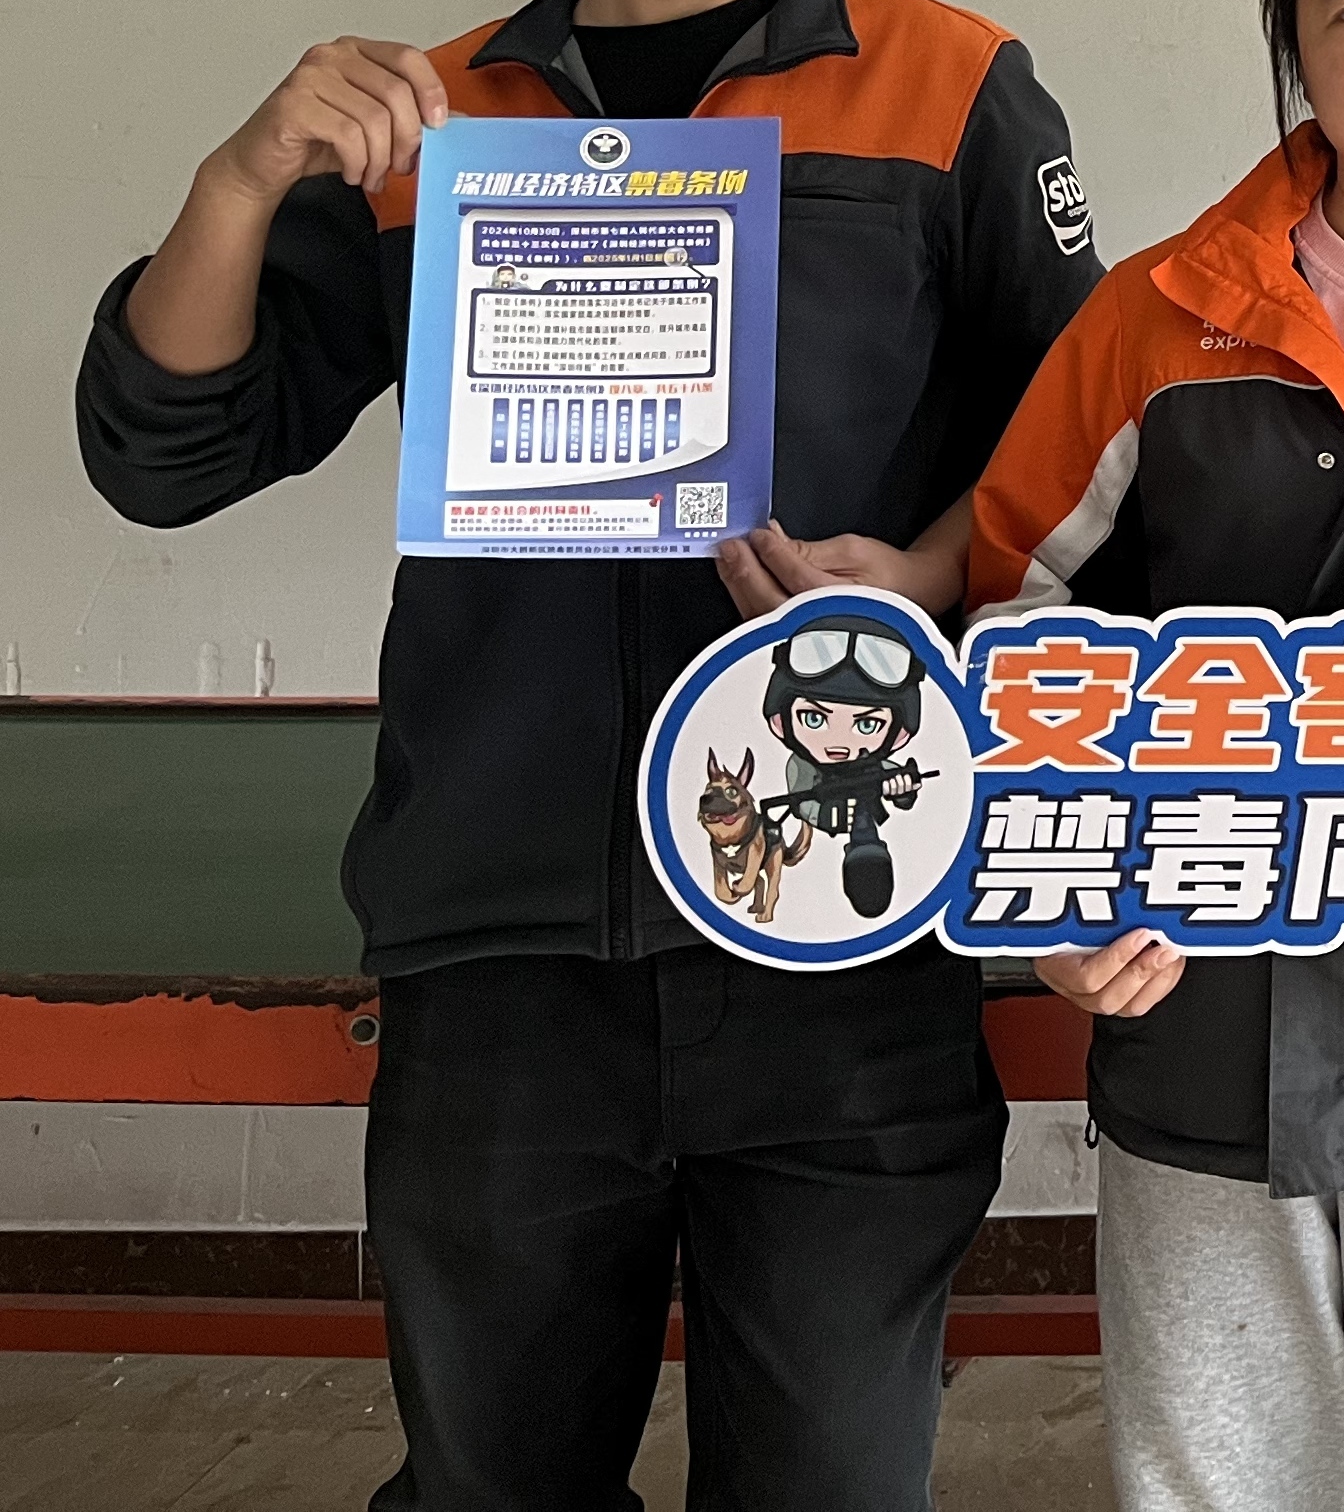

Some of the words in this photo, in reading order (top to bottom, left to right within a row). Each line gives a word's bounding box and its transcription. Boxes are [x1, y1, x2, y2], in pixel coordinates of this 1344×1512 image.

[451, 169, 748, 198] 深圳经济特区禁毒条例
